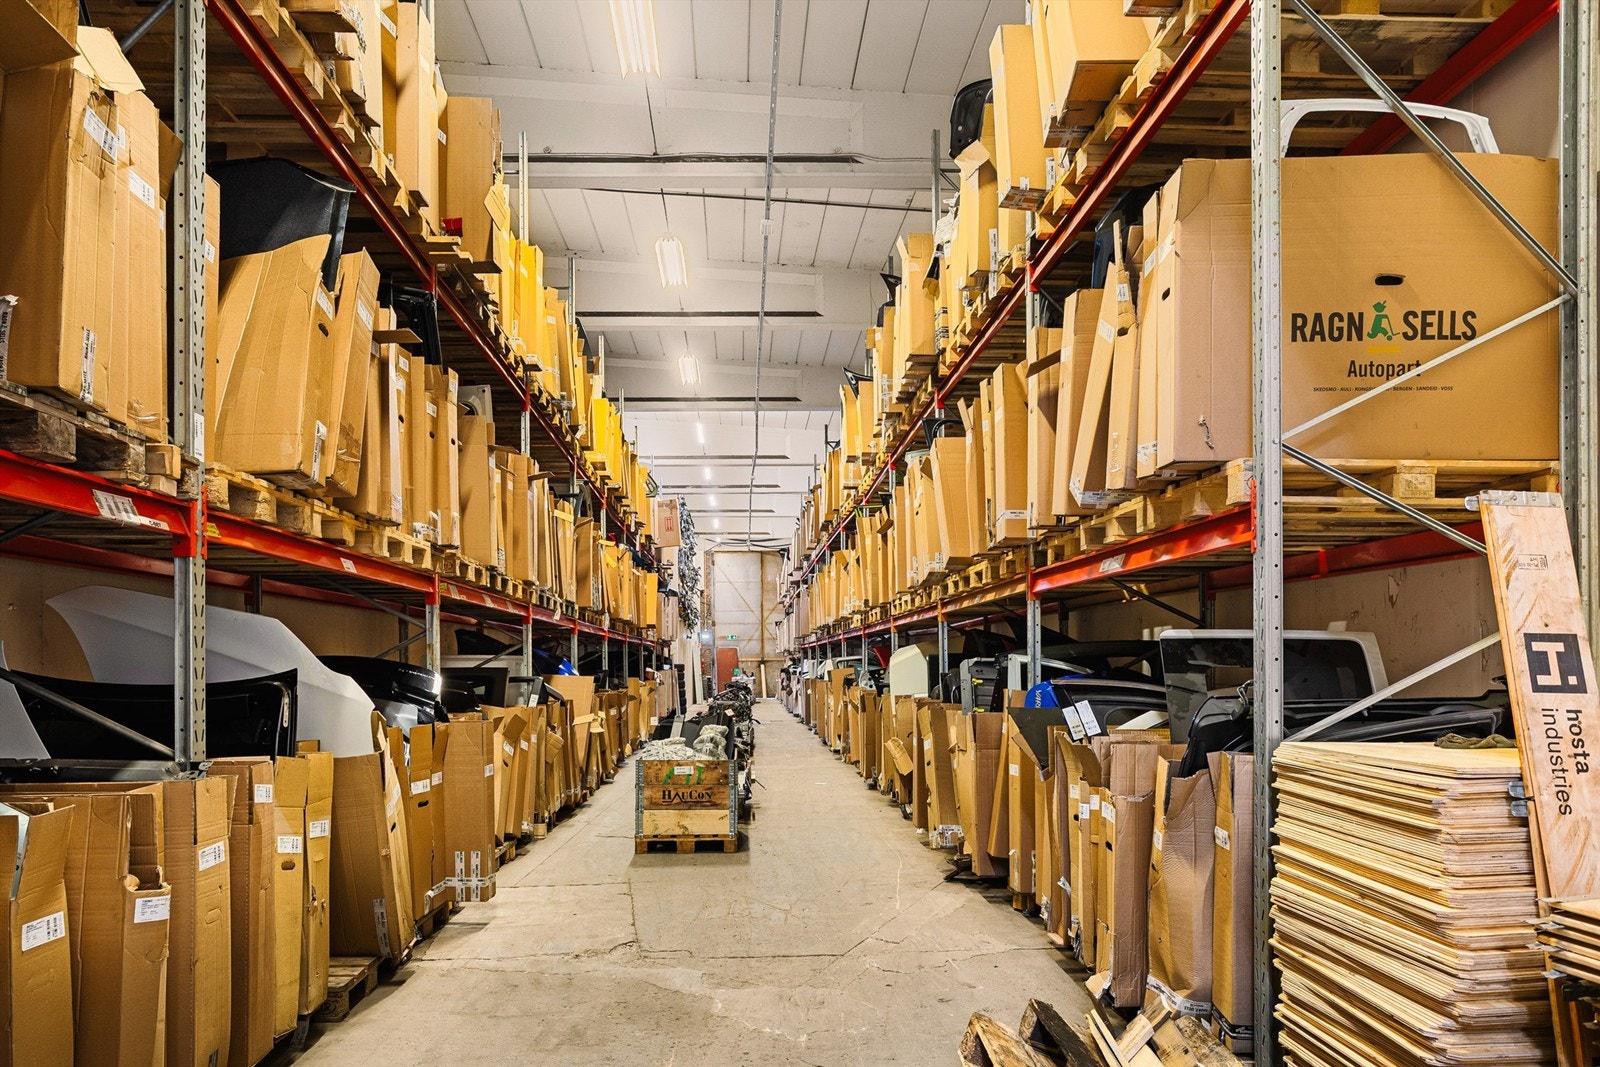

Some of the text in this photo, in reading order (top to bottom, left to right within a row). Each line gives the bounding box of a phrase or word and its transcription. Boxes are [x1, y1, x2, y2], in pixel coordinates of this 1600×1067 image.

[1291, 310, 1477, 342] RAGN SELLS
[1347, 359, 1422, 381] Autopart
[1541, 708, 1573, 816] industries
[1565, 708, 1589, 775] hosta
